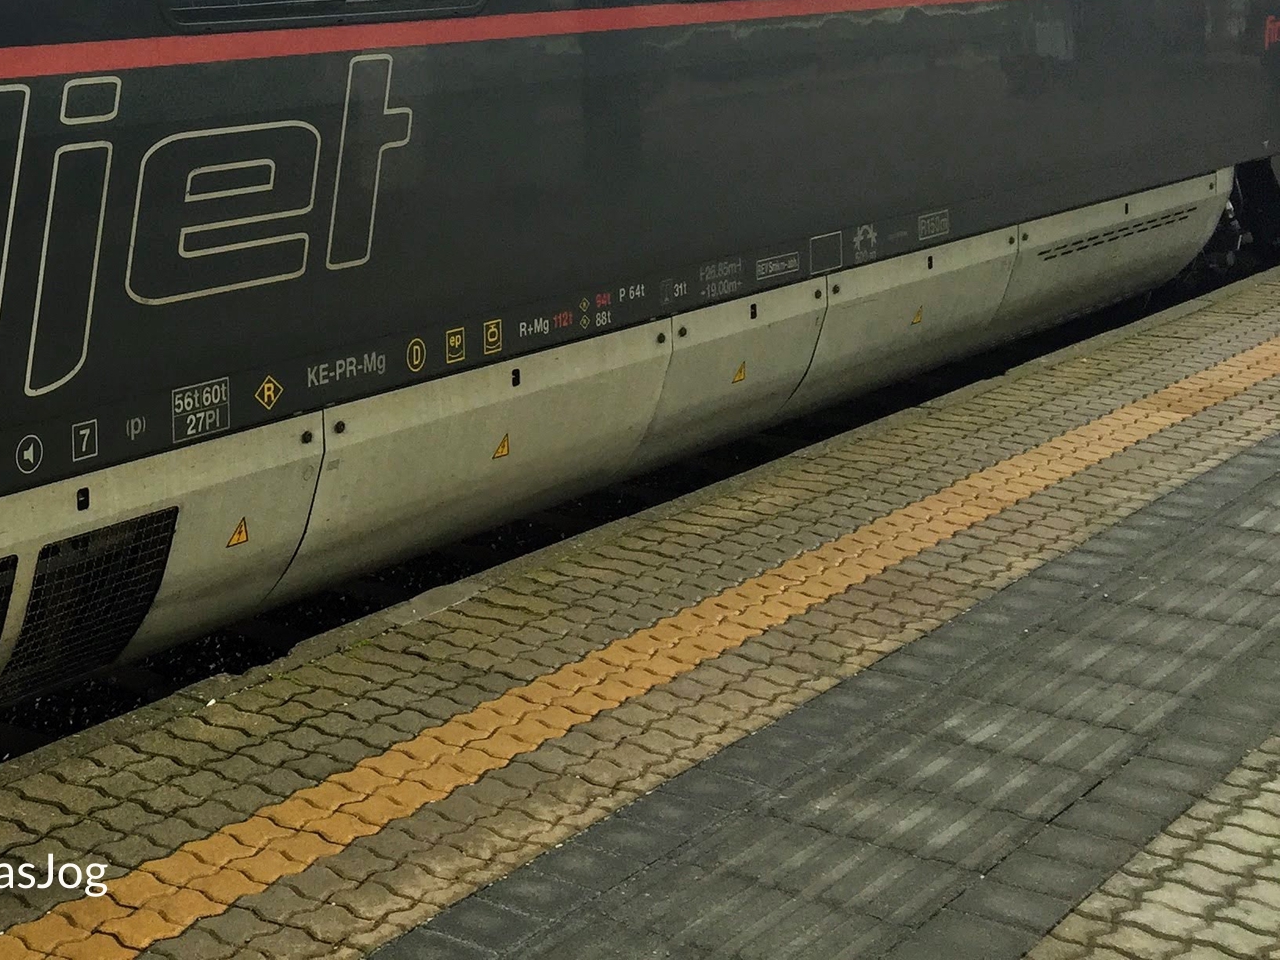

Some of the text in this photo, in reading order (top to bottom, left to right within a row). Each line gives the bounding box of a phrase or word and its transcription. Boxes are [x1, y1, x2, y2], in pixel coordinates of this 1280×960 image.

[629, 284, 645, 300] 64t
[519, 317, 549, 337] R+Mg
[595, 310, 611, 327] 88t
[449, 334, 462, 349] ep
[307, 351, 386, 388] KE-PR-Mg
[174, 383, 227, 413] 56t 60t
[263, 383, 275, 403] R
[126, 416, 146, 440] (p)
[79, 429, 91, 453] 7
